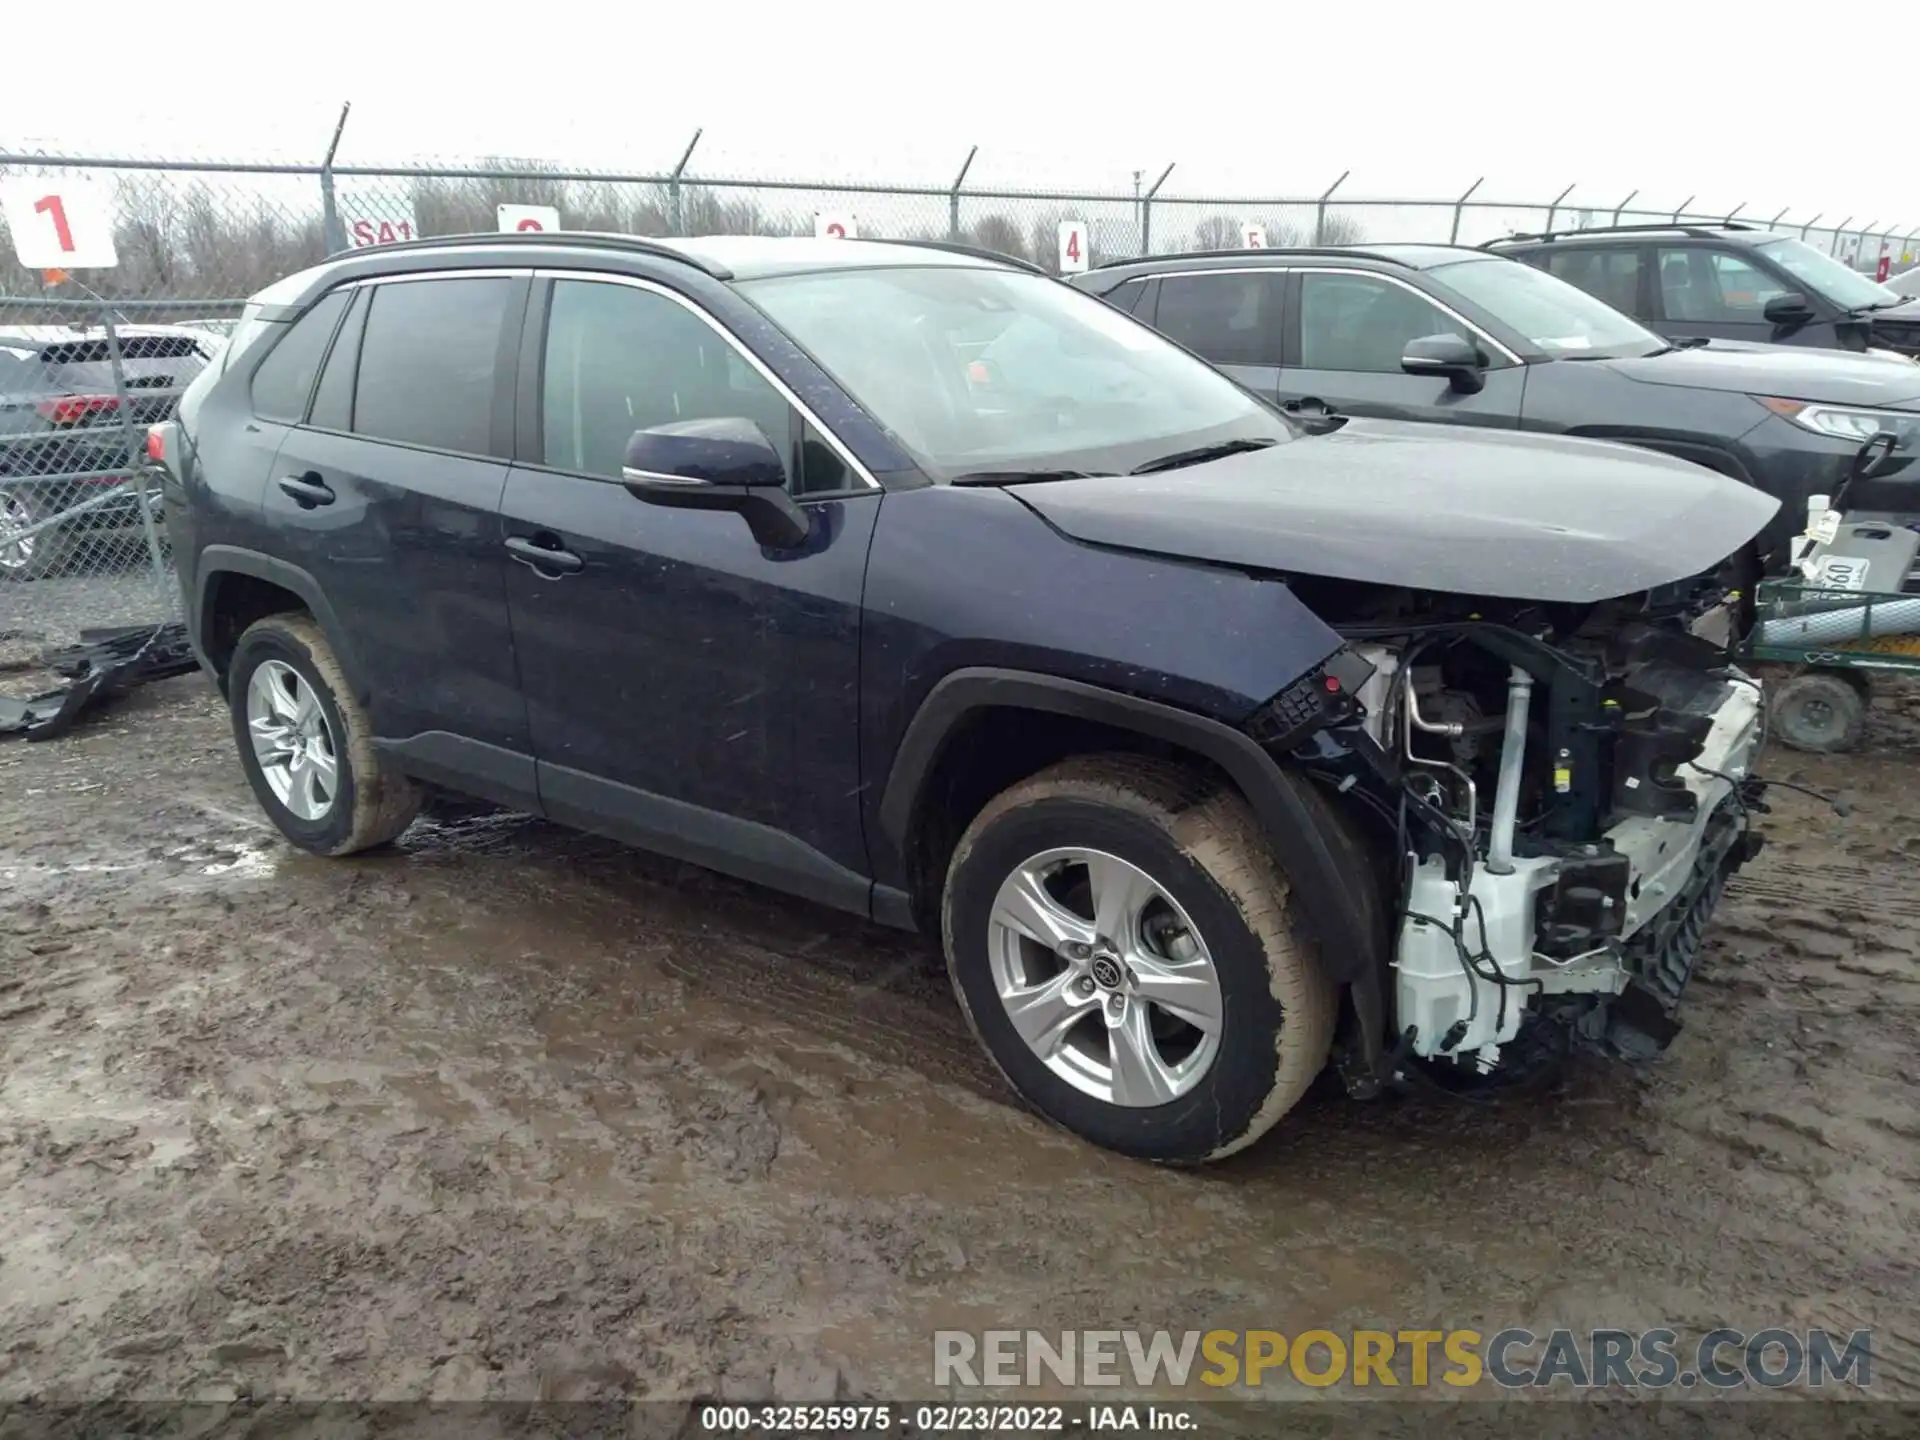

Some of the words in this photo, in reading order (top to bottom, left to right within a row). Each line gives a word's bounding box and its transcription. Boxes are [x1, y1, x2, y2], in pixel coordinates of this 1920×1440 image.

[34, 195, 75, 252] 1
[354, 220, 411, 247] SA1
[1066, 231, 1081, 263] 4
